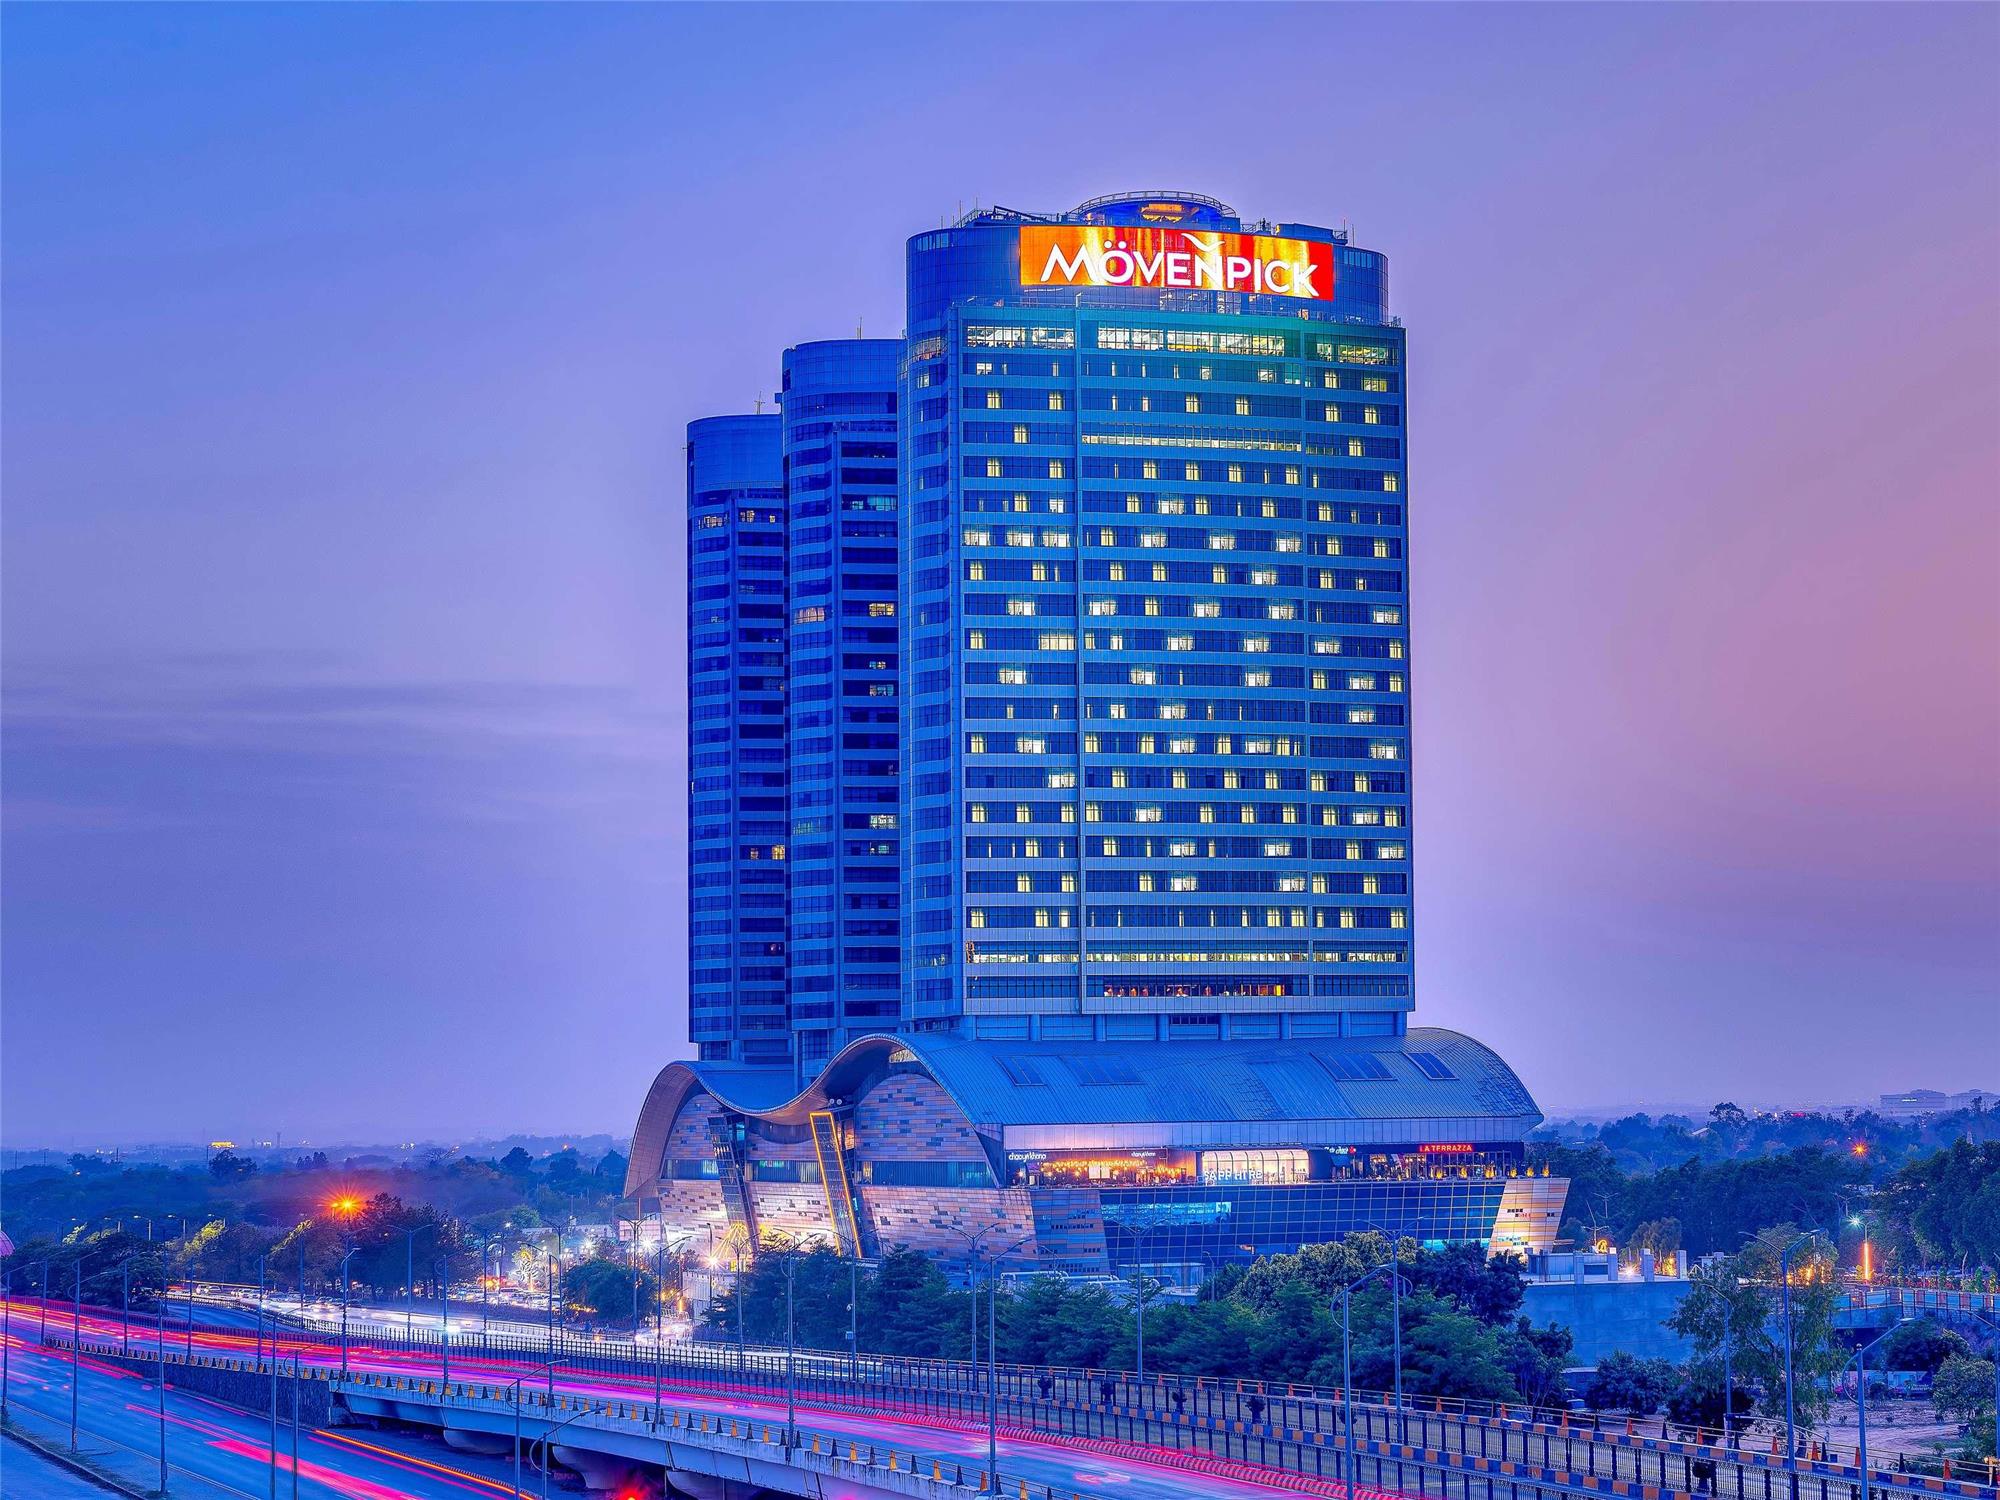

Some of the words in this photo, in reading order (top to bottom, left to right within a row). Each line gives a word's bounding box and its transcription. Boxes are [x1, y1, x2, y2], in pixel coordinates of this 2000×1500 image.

[1040, 239, 1320, 297] MÖVENPICK
[1419, 1144, 1430, 1152] LA
[1431, 1144, 1473, 1152] TERRAZZA
[1203, 1169, 1263, 1181] SAPPHIRE
